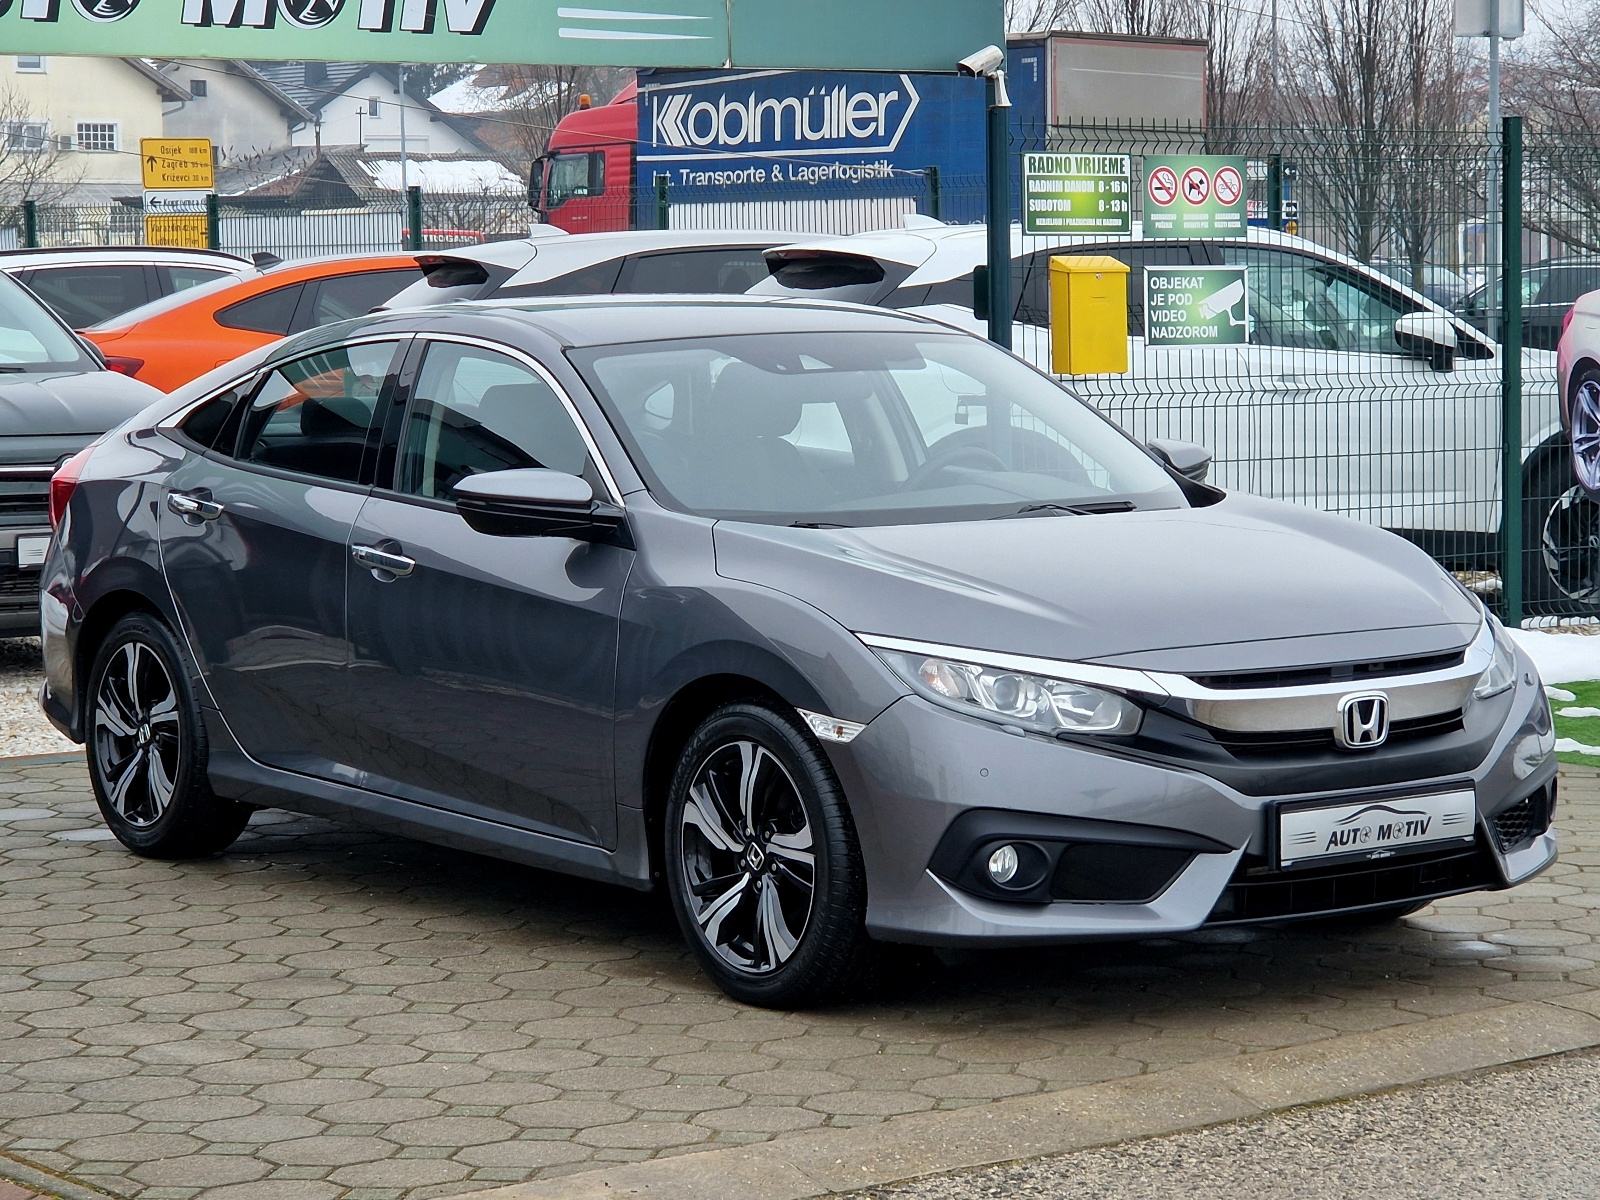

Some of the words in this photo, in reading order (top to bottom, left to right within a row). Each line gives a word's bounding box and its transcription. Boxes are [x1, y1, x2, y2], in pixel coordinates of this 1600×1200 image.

[652, 84, 899, 148] Koblmüller
[160, 146, 182, 156] Osijek
[161, 160, 188, 171] Zagreb
[1028, 156, 1072, 174] RADNO
[1074, 157, 1126, 175] VRIJEME
[652, 170, 675, 187] It.
[680, 166, 766, 189] Transporte
[771, 164, 784, 182] &
[788, 159, 895, 185] Lagerlogistik
[1028, 180, 1063, 193] RADNIM
[1110, 181, 1121, 193] 16
[1121, 181, 1128, 193] h
[1029, 199, 1072, 212] SUBOTOM
[1110, 200, 1121, 212] 13
[1121, 200, 1128, 212] h
[1150, 277, 1205, 290] OBJEKAT
[1150, 294, 1165, 306] JE
[1168, 293, 1193, 306] POD
[1150, 310, 1187, 322] VIDEO
[1151, 325, 1218, 339] NADZOROM
[1325, 826, 1372, 851] AUTO
[1377, 816, 1432, 841] MOTIV
